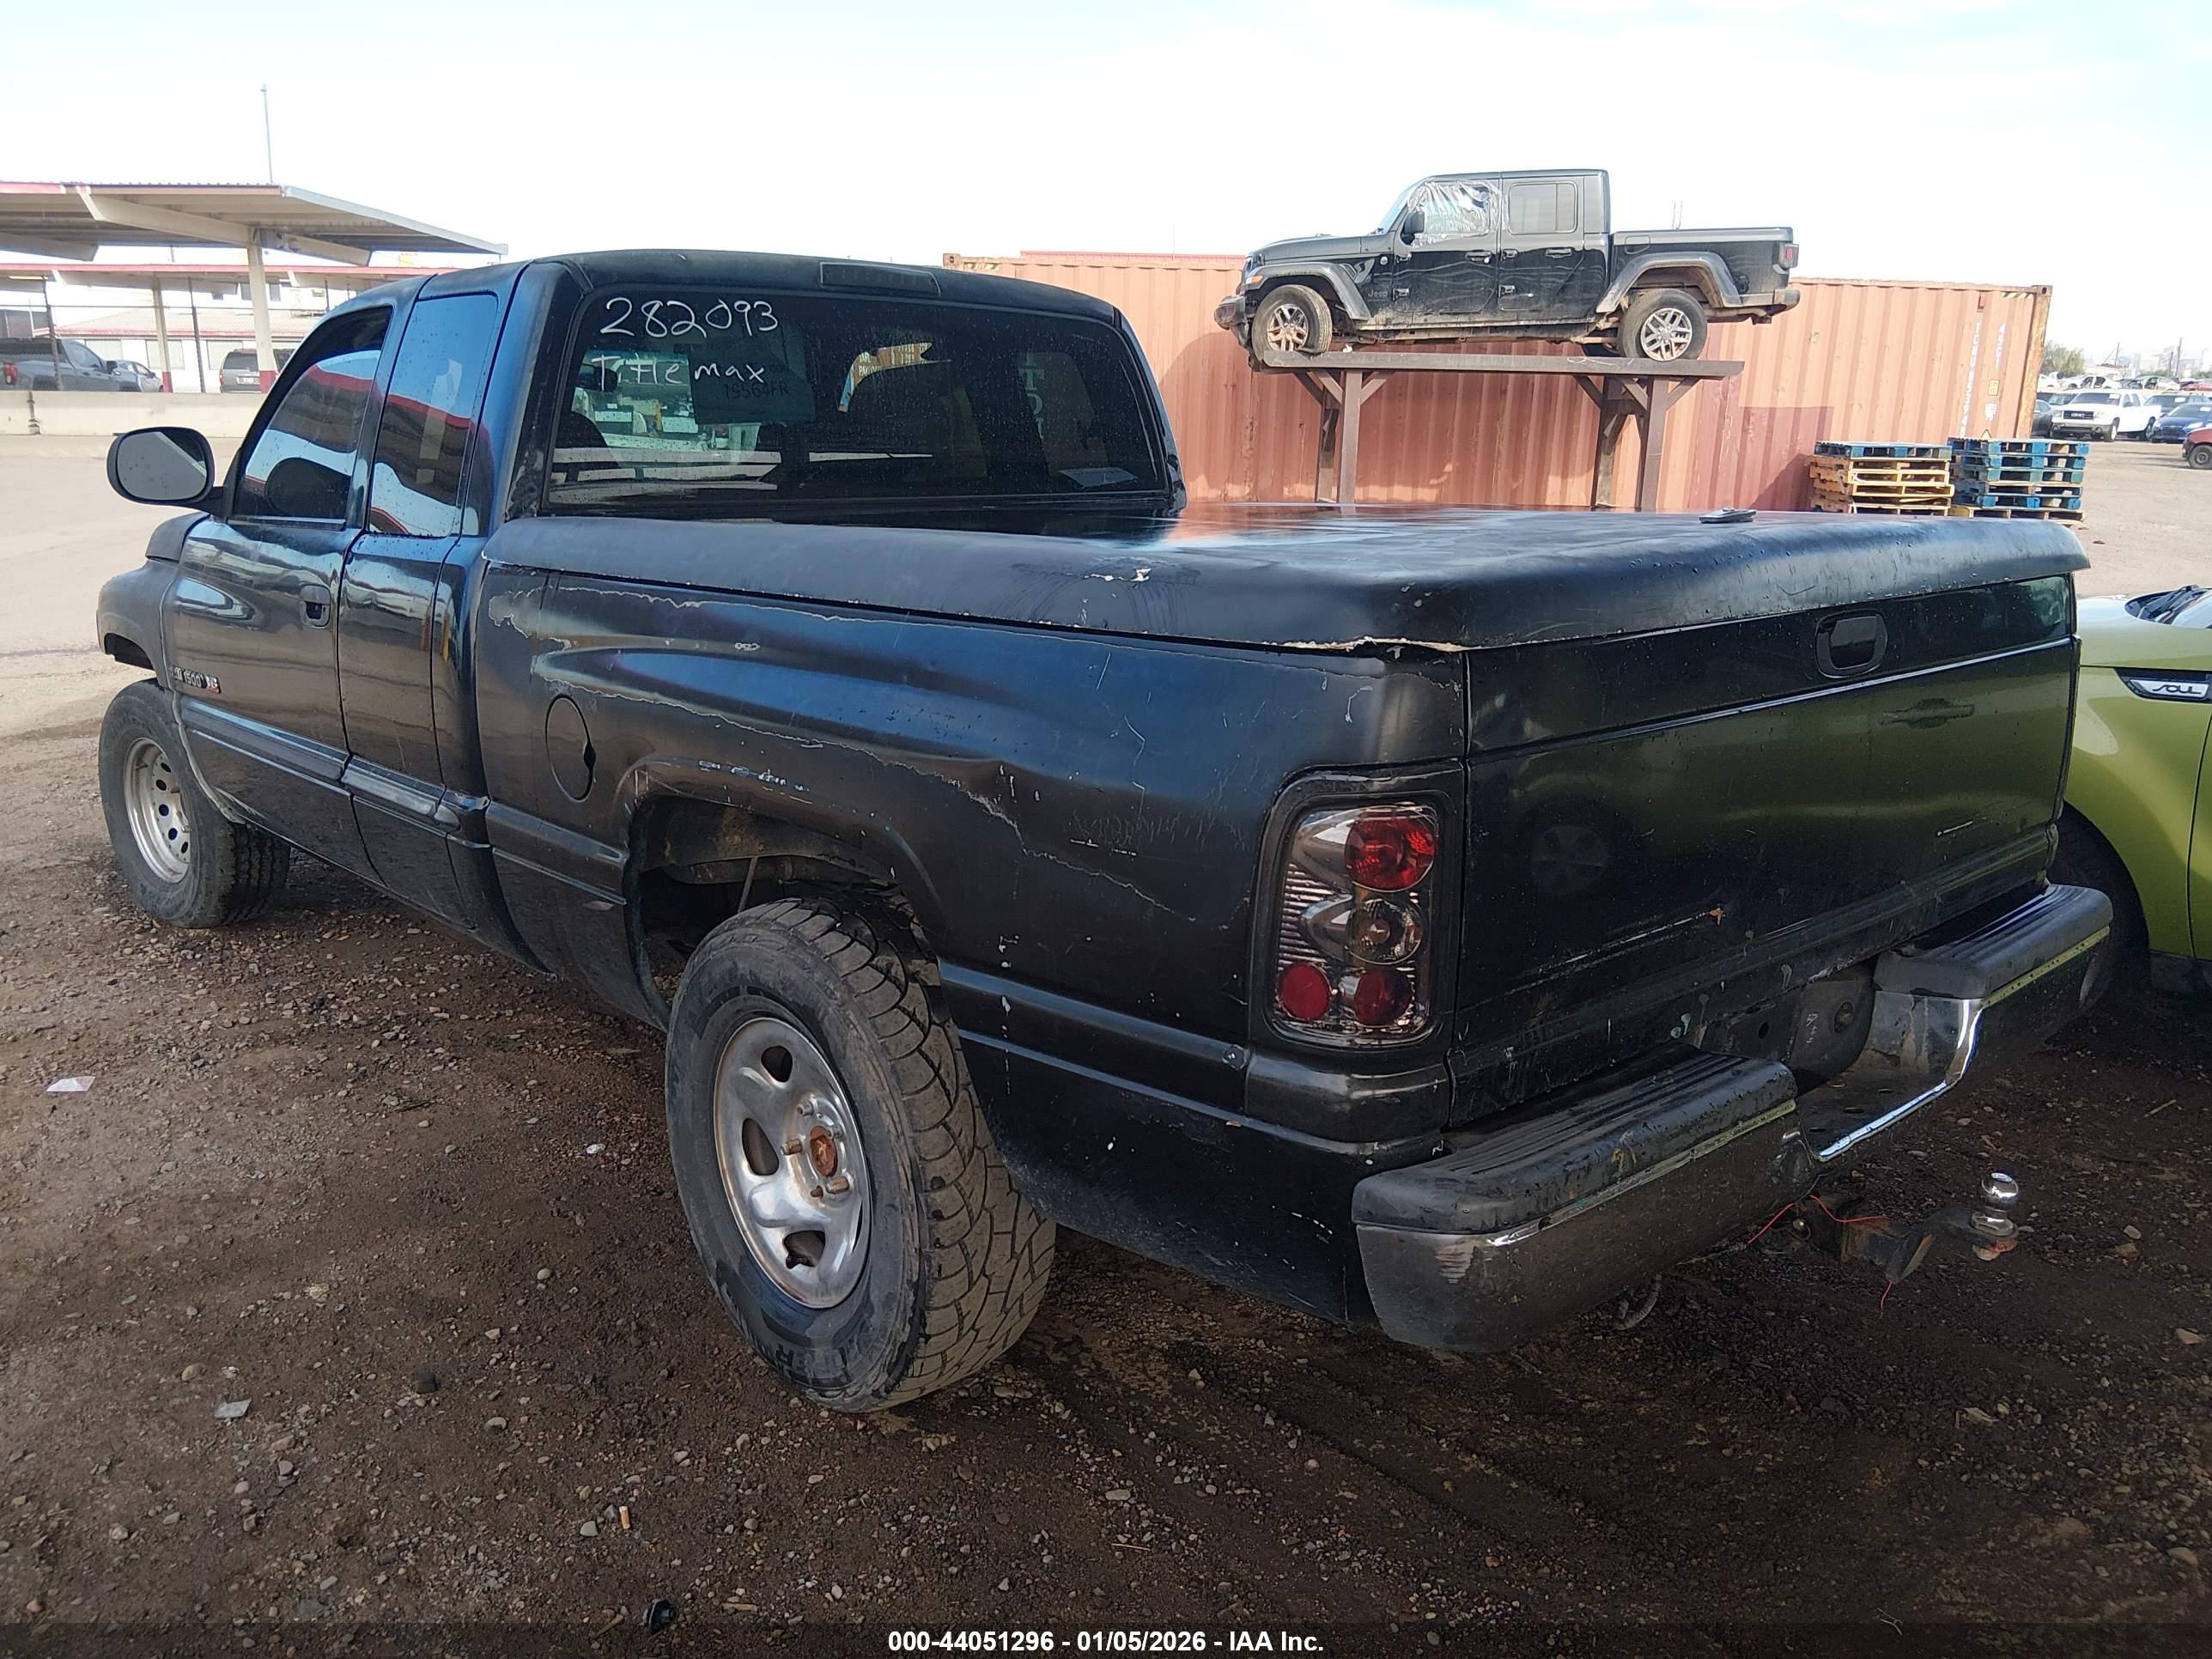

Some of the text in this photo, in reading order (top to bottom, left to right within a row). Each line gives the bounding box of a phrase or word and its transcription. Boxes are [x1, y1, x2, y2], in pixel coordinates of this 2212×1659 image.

[1367, 289, 1389, 298] Jeep
[599, 296, 779, 339] 282093
[184, 671, 202, 688] 1500
[2152, 684, 2202, 695] SOUL
